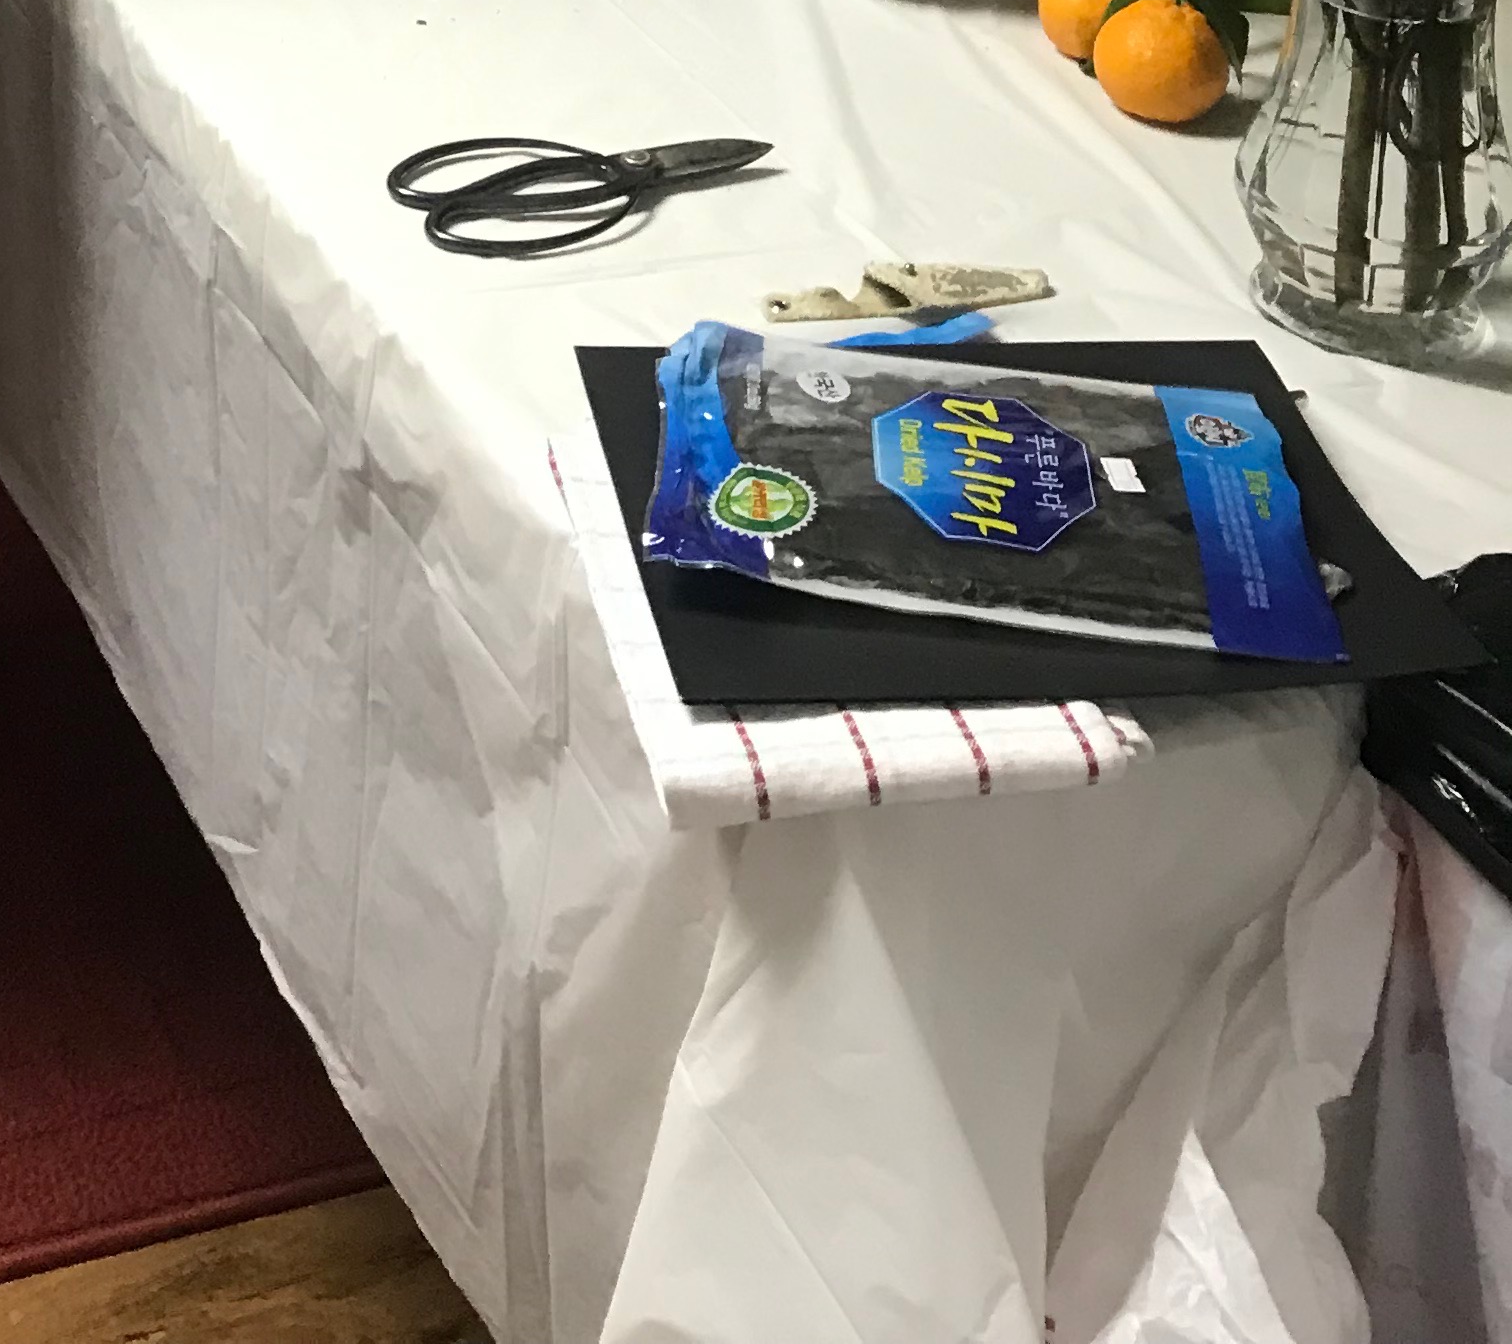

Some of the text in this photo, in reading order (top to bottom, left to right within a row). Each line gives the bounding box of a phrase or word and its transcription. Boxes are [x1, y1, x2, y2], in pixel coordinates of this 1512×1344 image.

[899, 418, 929, 487] Dried Kelp
[933, 398, 1018, 537] 다시마
